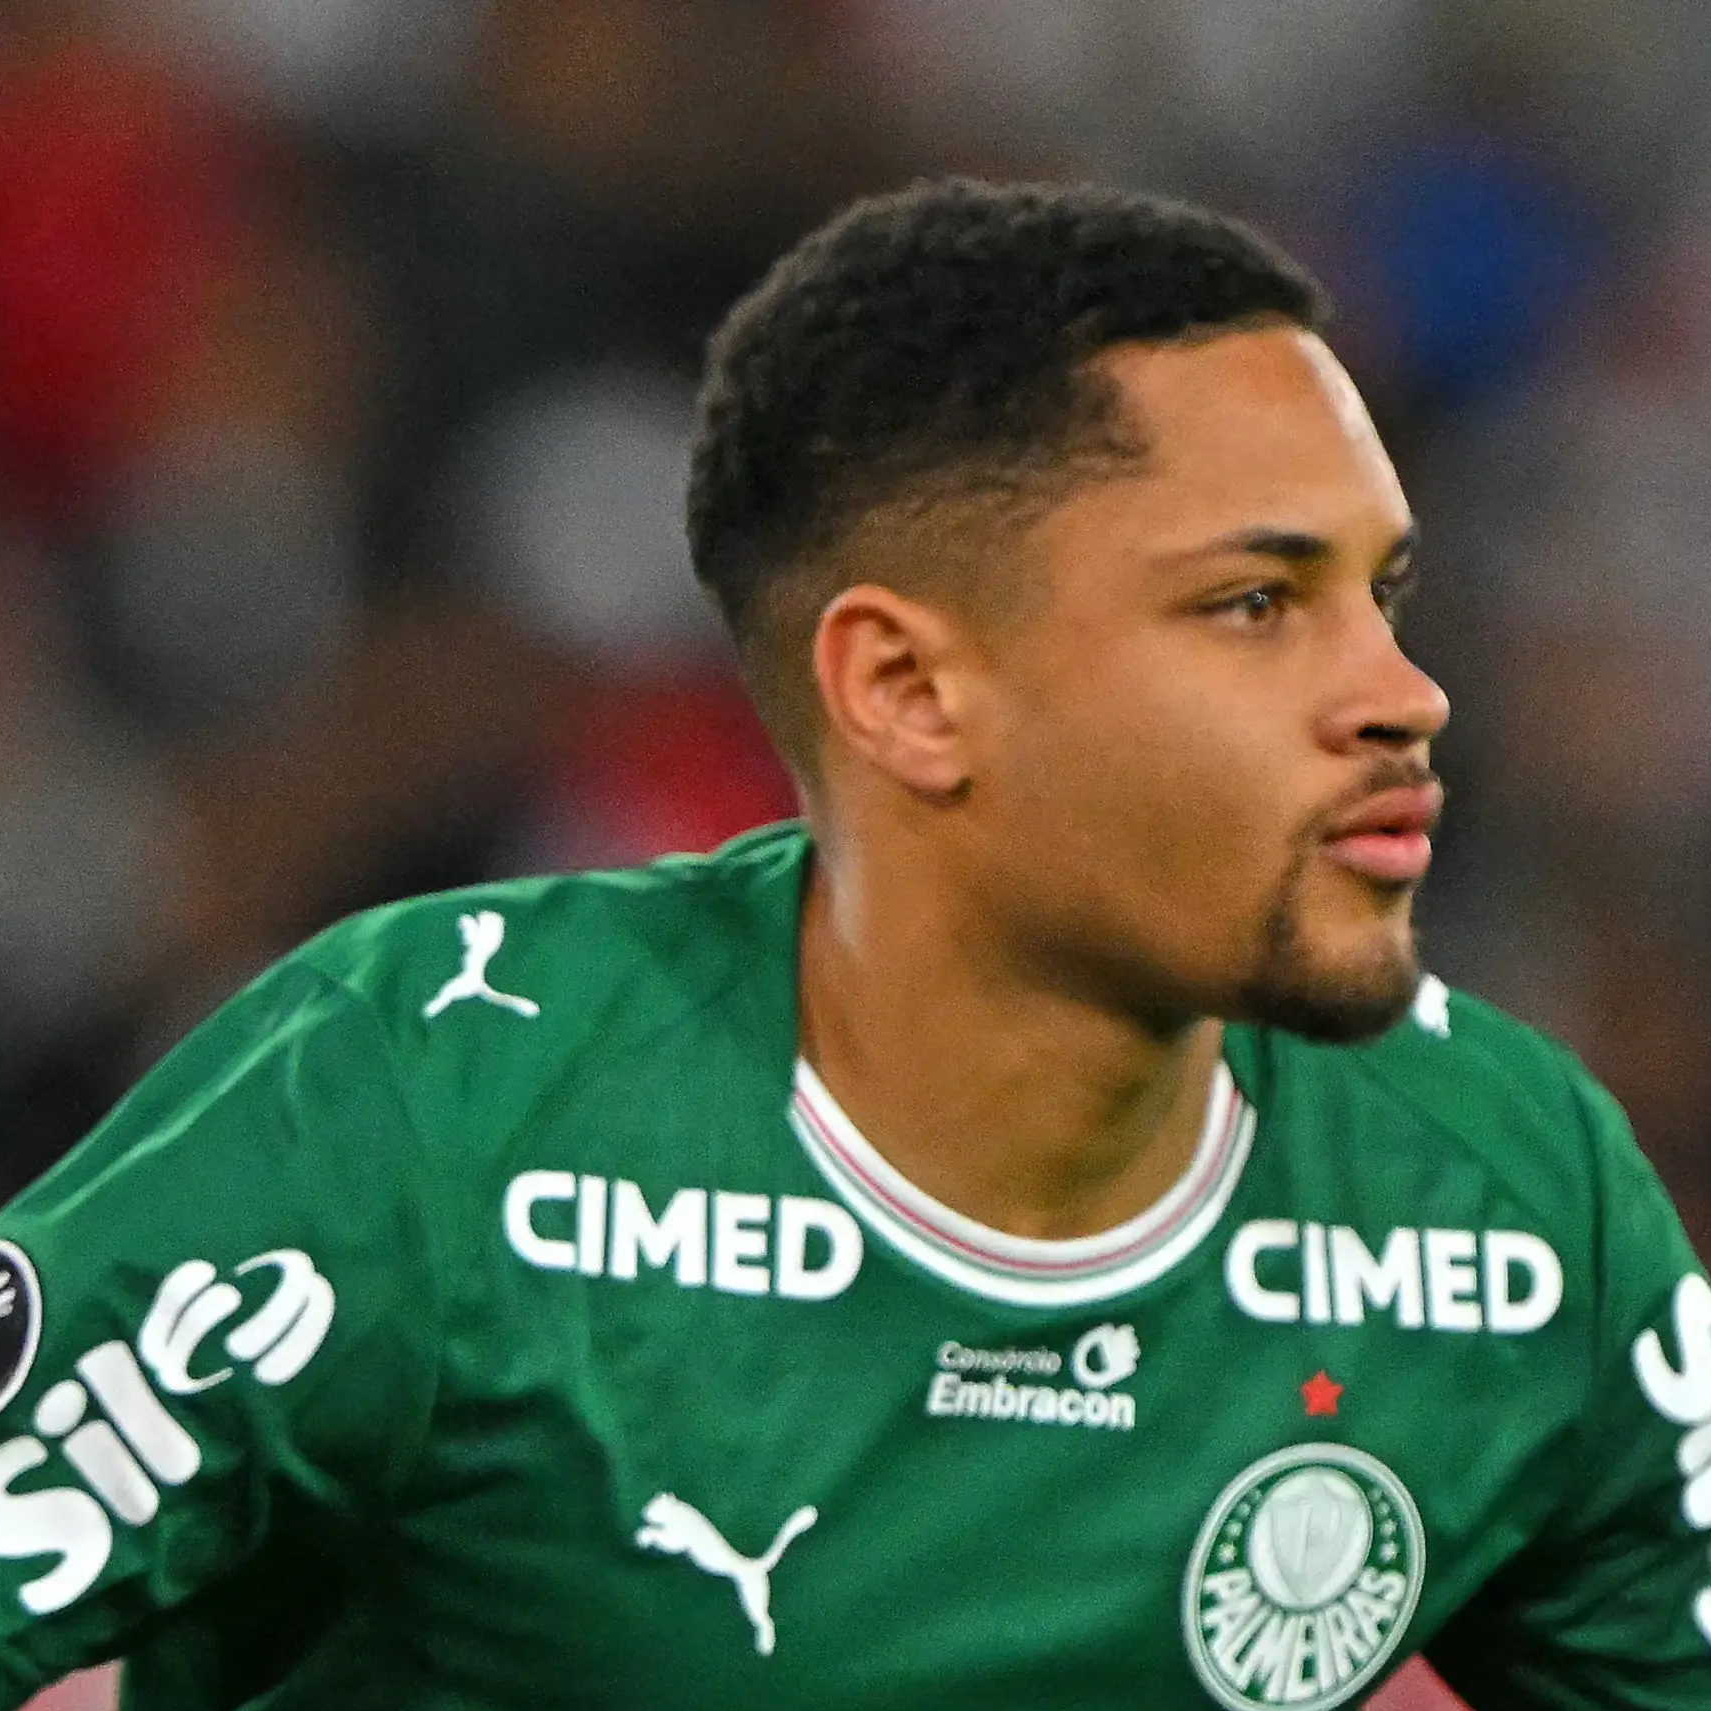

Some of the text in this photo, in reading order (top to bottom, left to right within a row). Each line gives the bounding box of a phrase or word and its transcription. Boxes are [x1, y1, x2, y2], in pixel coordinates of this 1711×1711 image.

[502, 1169, 864, 1301] CIMED
[1223, 1218, 1564, 1334] CIMED
[927, 1371, 1137, 1430] Embracon
[1201, 1566, 1408, 1702] PALMEIRAS
